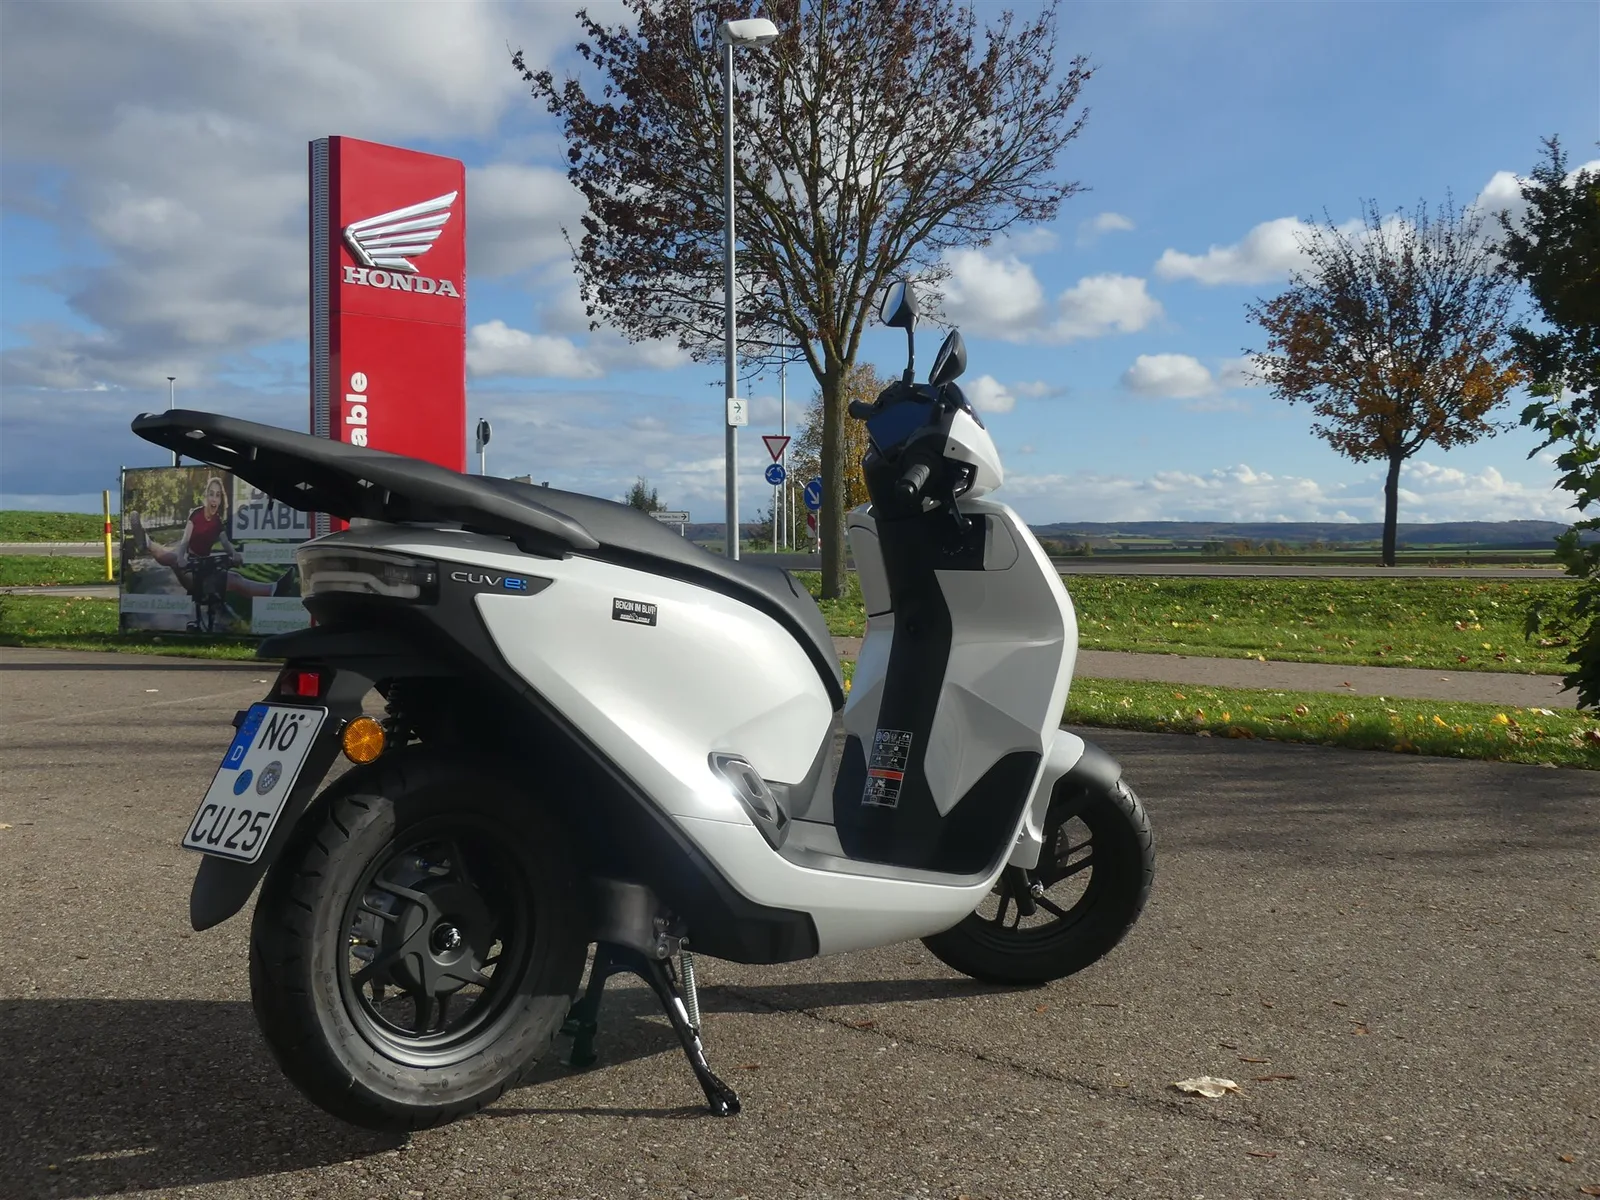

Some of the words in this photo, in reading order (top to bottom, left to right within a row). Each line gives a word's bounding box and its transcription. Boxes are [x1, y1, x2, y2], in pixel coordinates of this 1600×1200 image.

[343, 266, 461, 298] HONDA
[450, 571, 502, 586] CUV
[615, 600, 634, 611] BENZIN
[634, 602, 642, 612] IM
[258, 711, 306, 752] NÖ
[230, 745, 244, 762] D
